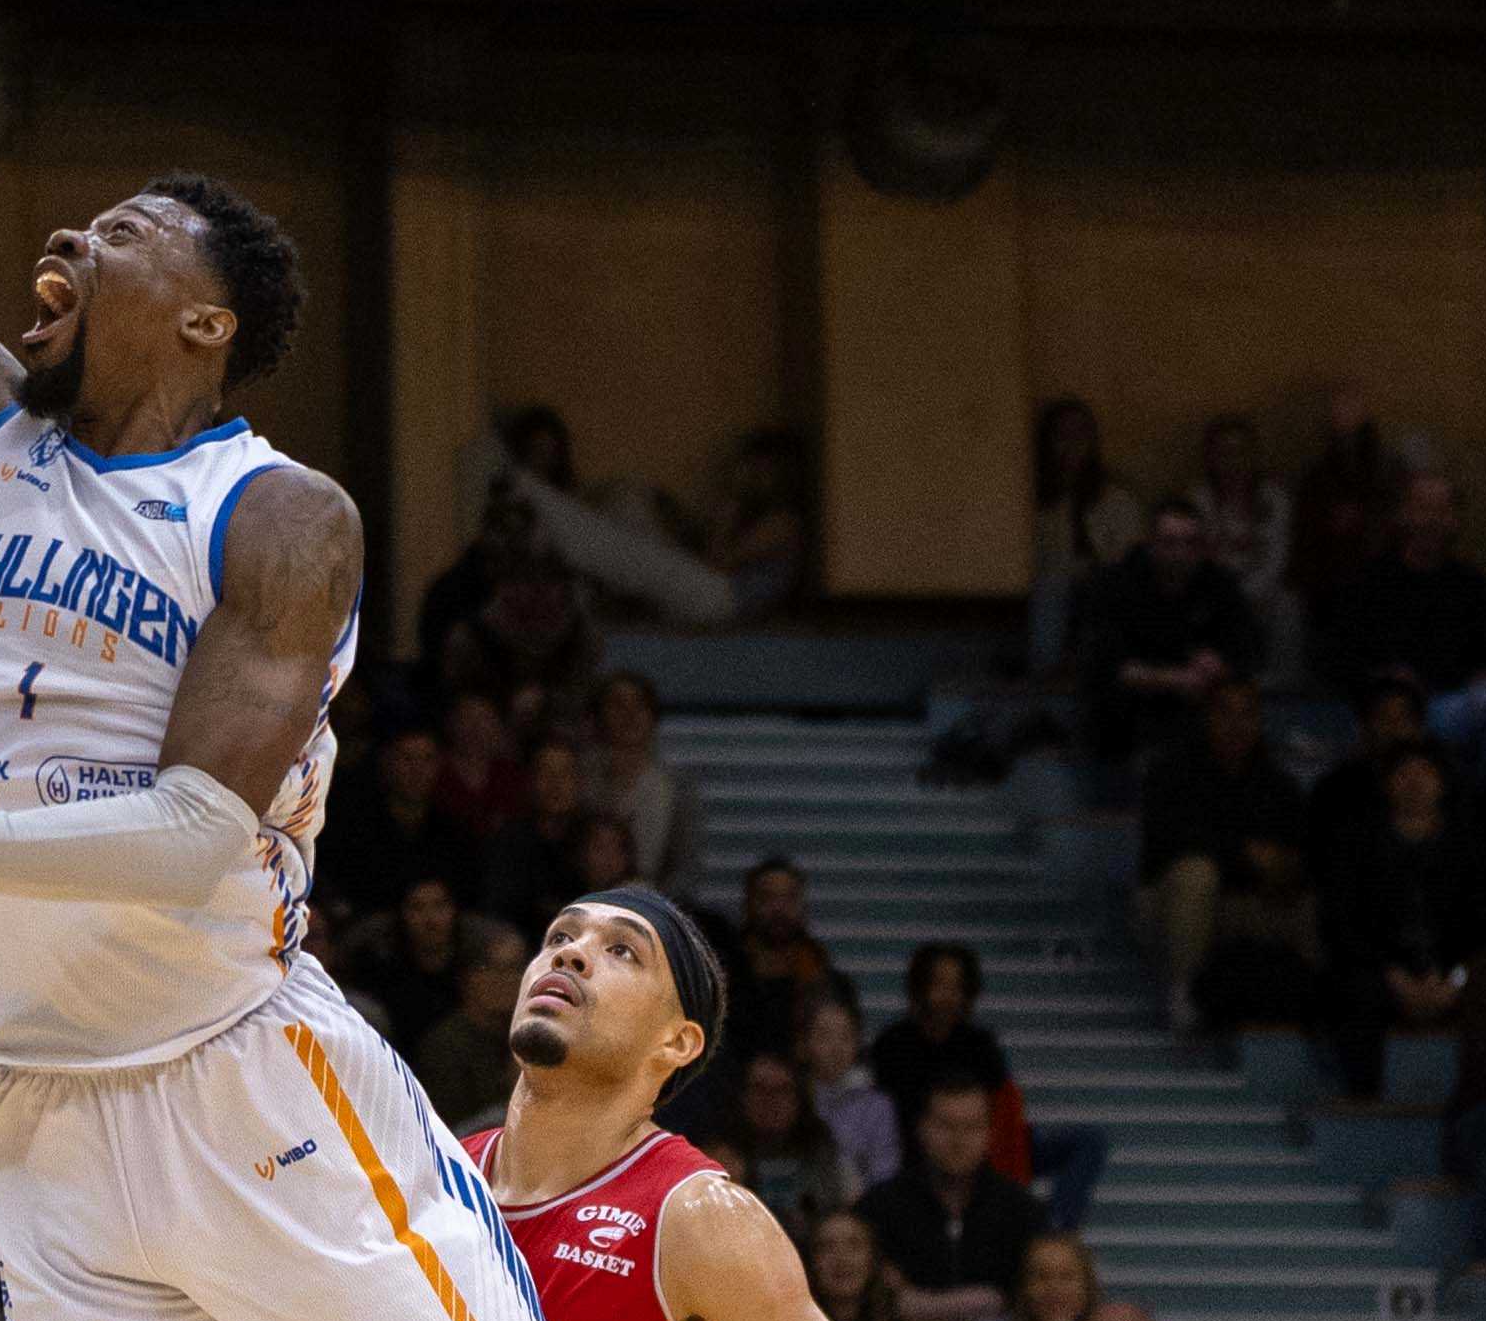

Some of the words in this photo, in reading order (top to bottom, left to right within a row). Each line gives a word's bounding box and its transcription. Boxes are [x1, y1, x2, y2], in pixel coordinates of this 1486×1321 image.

[17, 660, 47, 721] 1
[78, 764, 156, 790] HALTB
[275, 1137, 318, 1168] WIBO
[552, 1241, 636, 1278] BASKET
